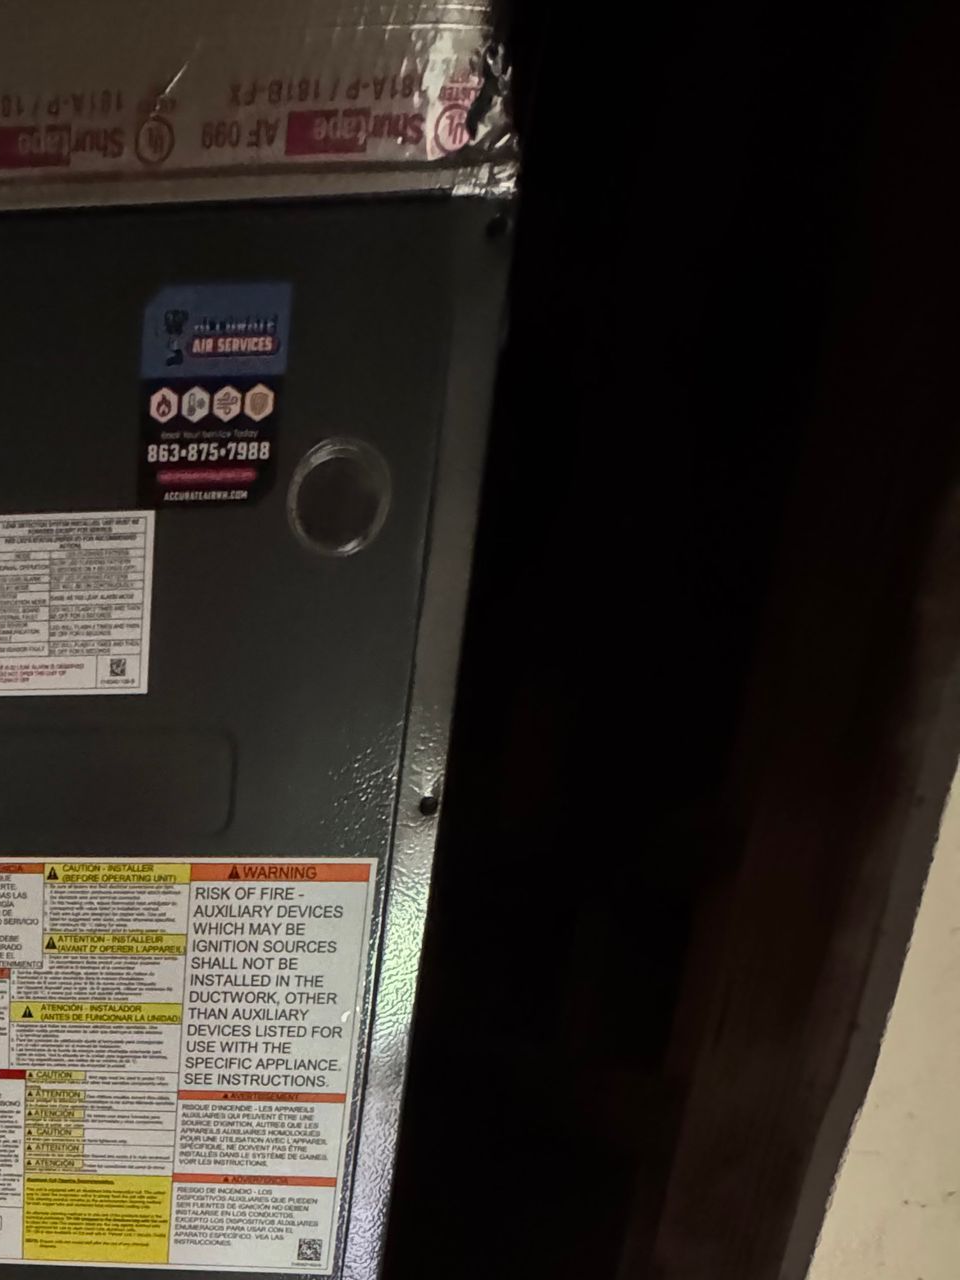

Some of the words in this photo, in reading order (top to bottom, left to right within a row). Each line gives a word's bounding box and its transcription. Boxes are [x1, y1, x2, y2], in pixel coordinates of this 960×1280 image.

[192, 337, 213, 353] AIR
[218, 336, 273, 352] SERVICES
[62, 864, 101, 872] CAUTION
[108, 864, 154, 872] INSTALLER
[243, 866, 317, 880] WARNING
[62, 874, 99, 883] (BEFORE
[102, 874, 151, 883] OPERATING
[154, 874, 176, 883] UNIT)
[195, 887, 230, 900] RISK
[235, 887, 256, 900] OF
[260, 888, 295, 900] FIRE
[193, 905, 273, 918] AUXILIARY
[277, 906, 344, 918] DEVICES
[193, 923, 245, 935] WHICH
[249, 923, 282, 936] MAY
[286, 923, 306, 936] BE
[112, 936, 163, 944] INSTALLEUR
[192, 940, 258, 953] IGNITION
[262, 940, 337, 953] SOURCES
[191, 957, 237, 970] SHALL
[242, 958, 274, 970] NOT
[278, 958, 298, 970] BE
[191, 974, 271, 987] INSTALLED
[275, 975, 290, 987] IN
[294, 975, 324, 987] THE
[190, 991, 280, 1006] DUCTWORK,
[285, 993, 338, 1004] OTHER
[189, 1008, 228, 1020] THAN
[232, 1008, 309, 1021] AUXILIARY
[187, 1025, 251, 1037] DEVICES
[256, 1025, 307, 1038] LISTED
[311, 1026, 343, 1038] FOR
[187, 1041, 216, 1053] USE
[220, 1042, 258, 1054] WITH
[262, 1042, 292, 1054] THE
[185, 1057, 252, 1070] SPECIFIC
[255, 1058, 342, 1071] APPLIANCE.
[184, 1073, 212, 1085] SEE
[217, 1074, 329, 1088] INSTRUCTIONS.
